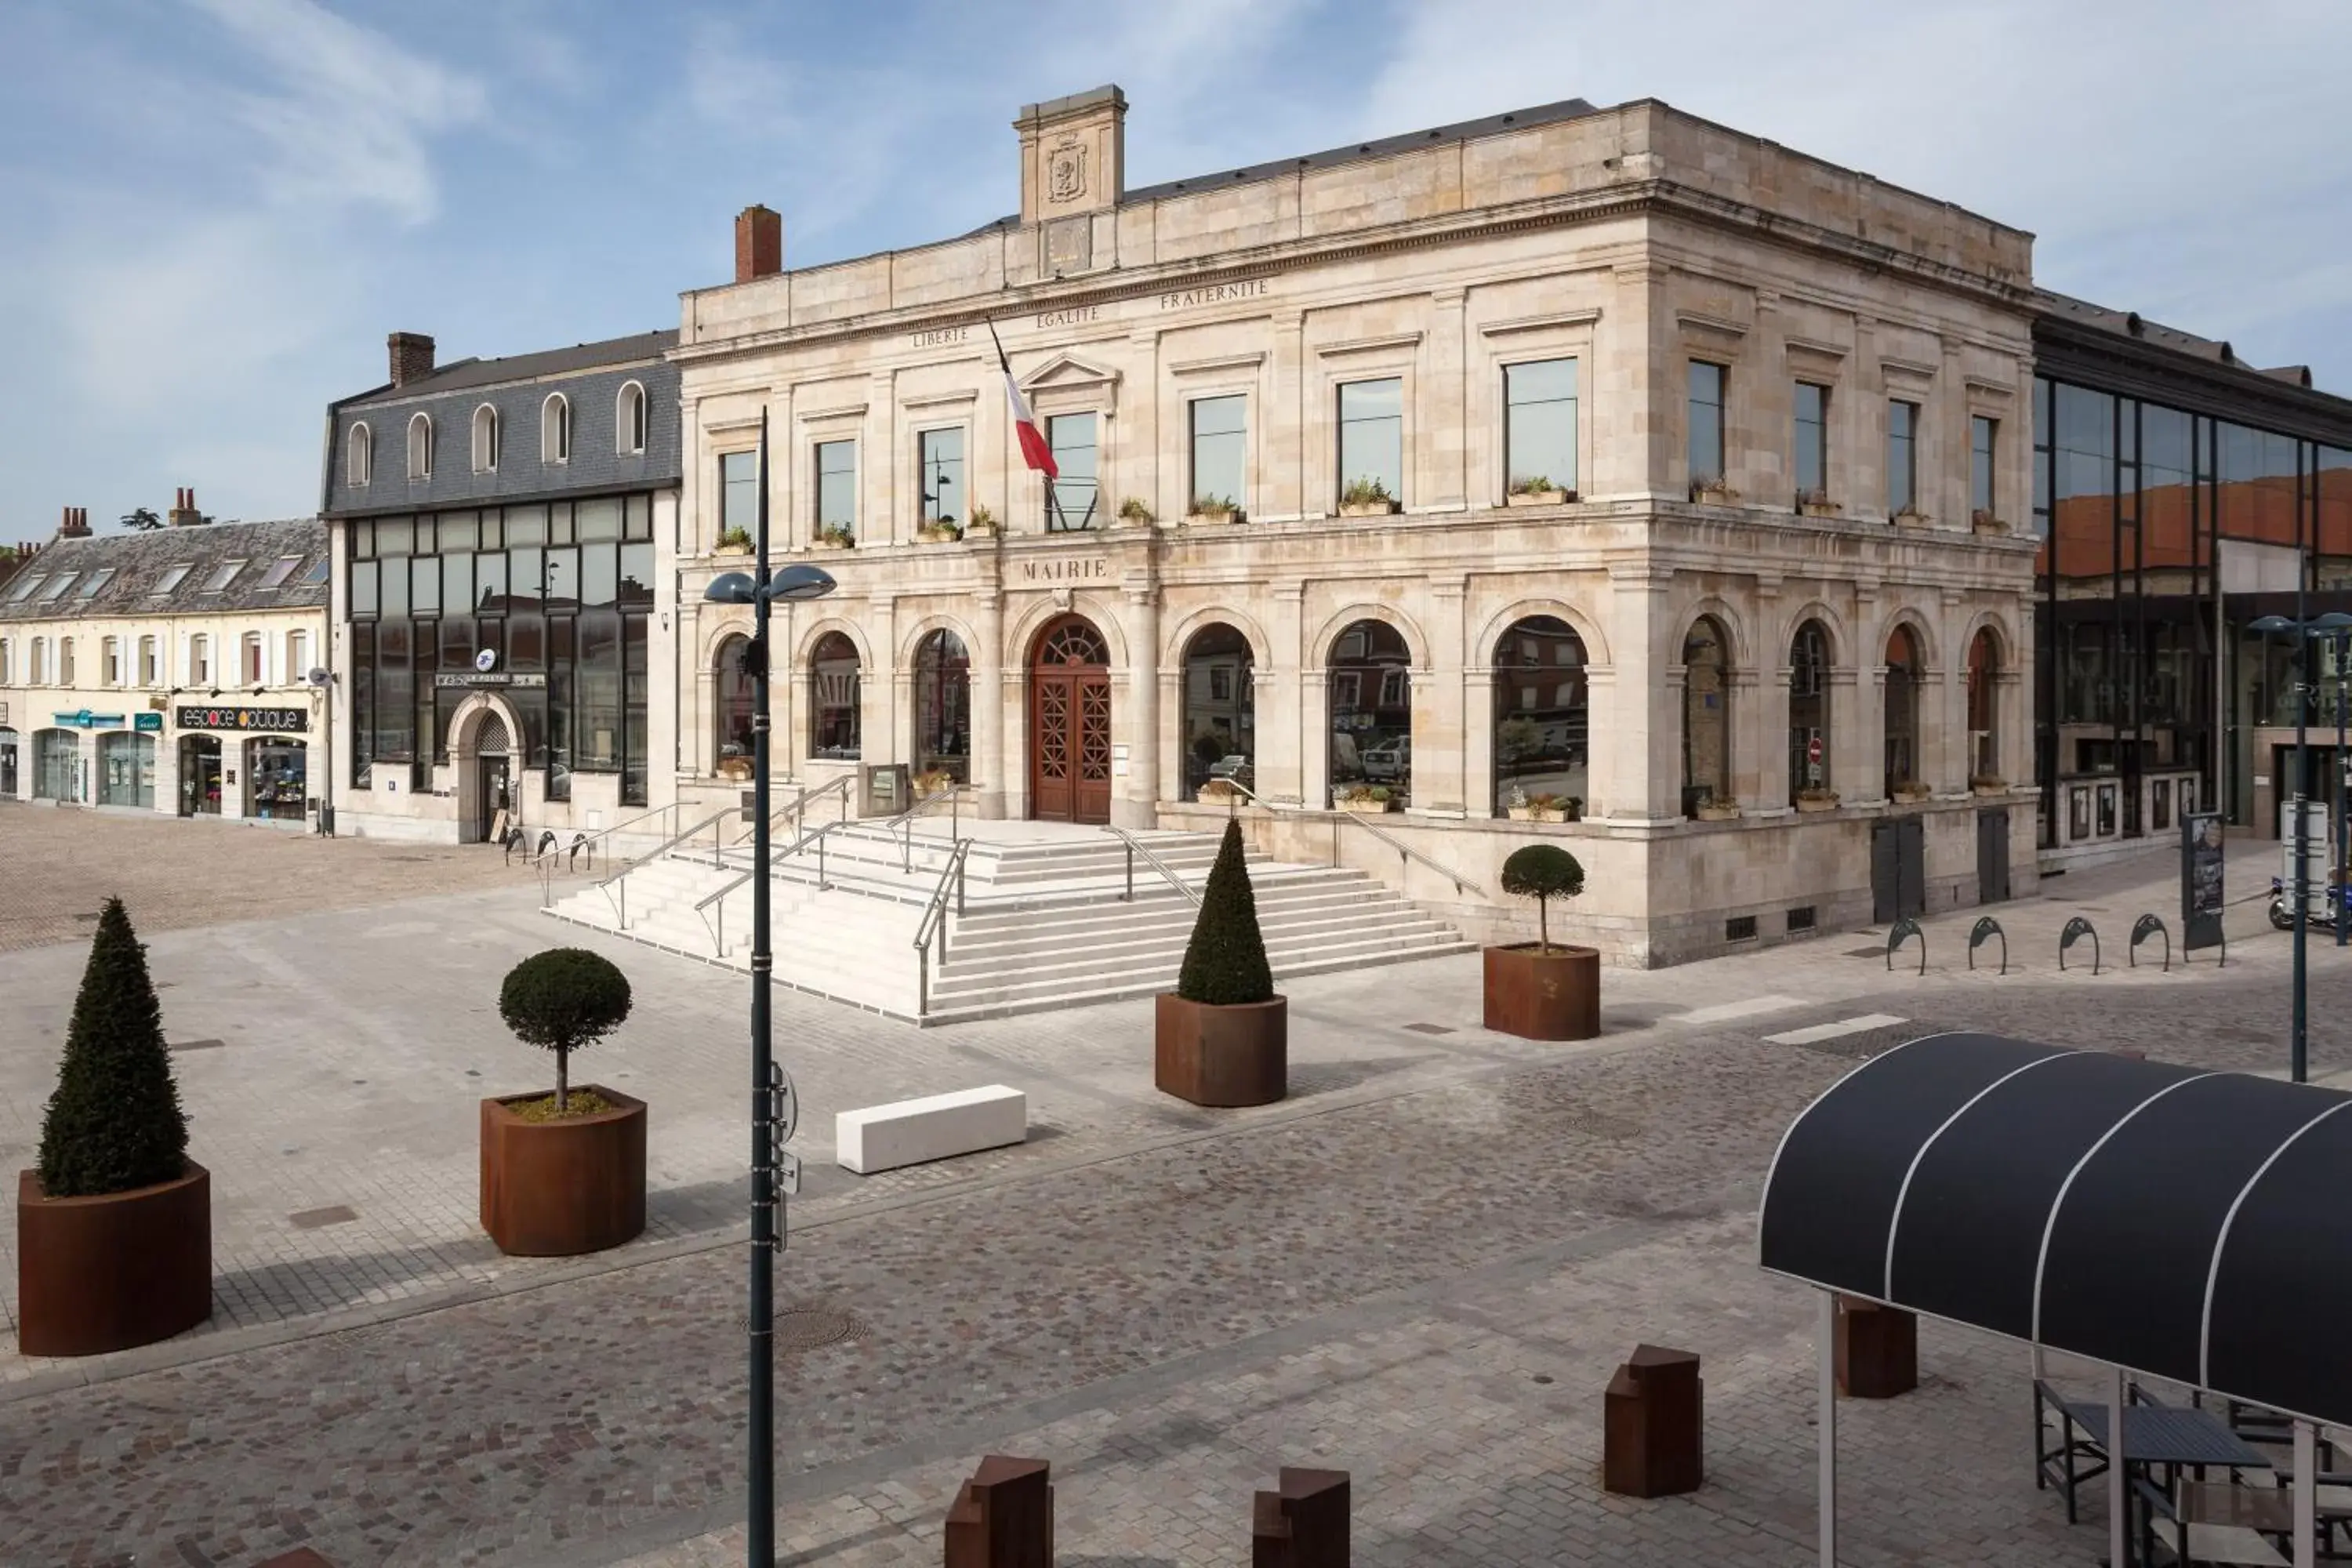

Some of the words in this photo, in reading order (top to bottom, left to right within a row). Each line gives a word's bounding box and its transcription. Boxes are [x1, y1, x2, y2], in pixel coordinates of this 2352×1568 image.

[1022, 560, 1107, 581] MAIRIE
[184, 709, 234, 729] espace
[238, 707, 297, 731] optique
